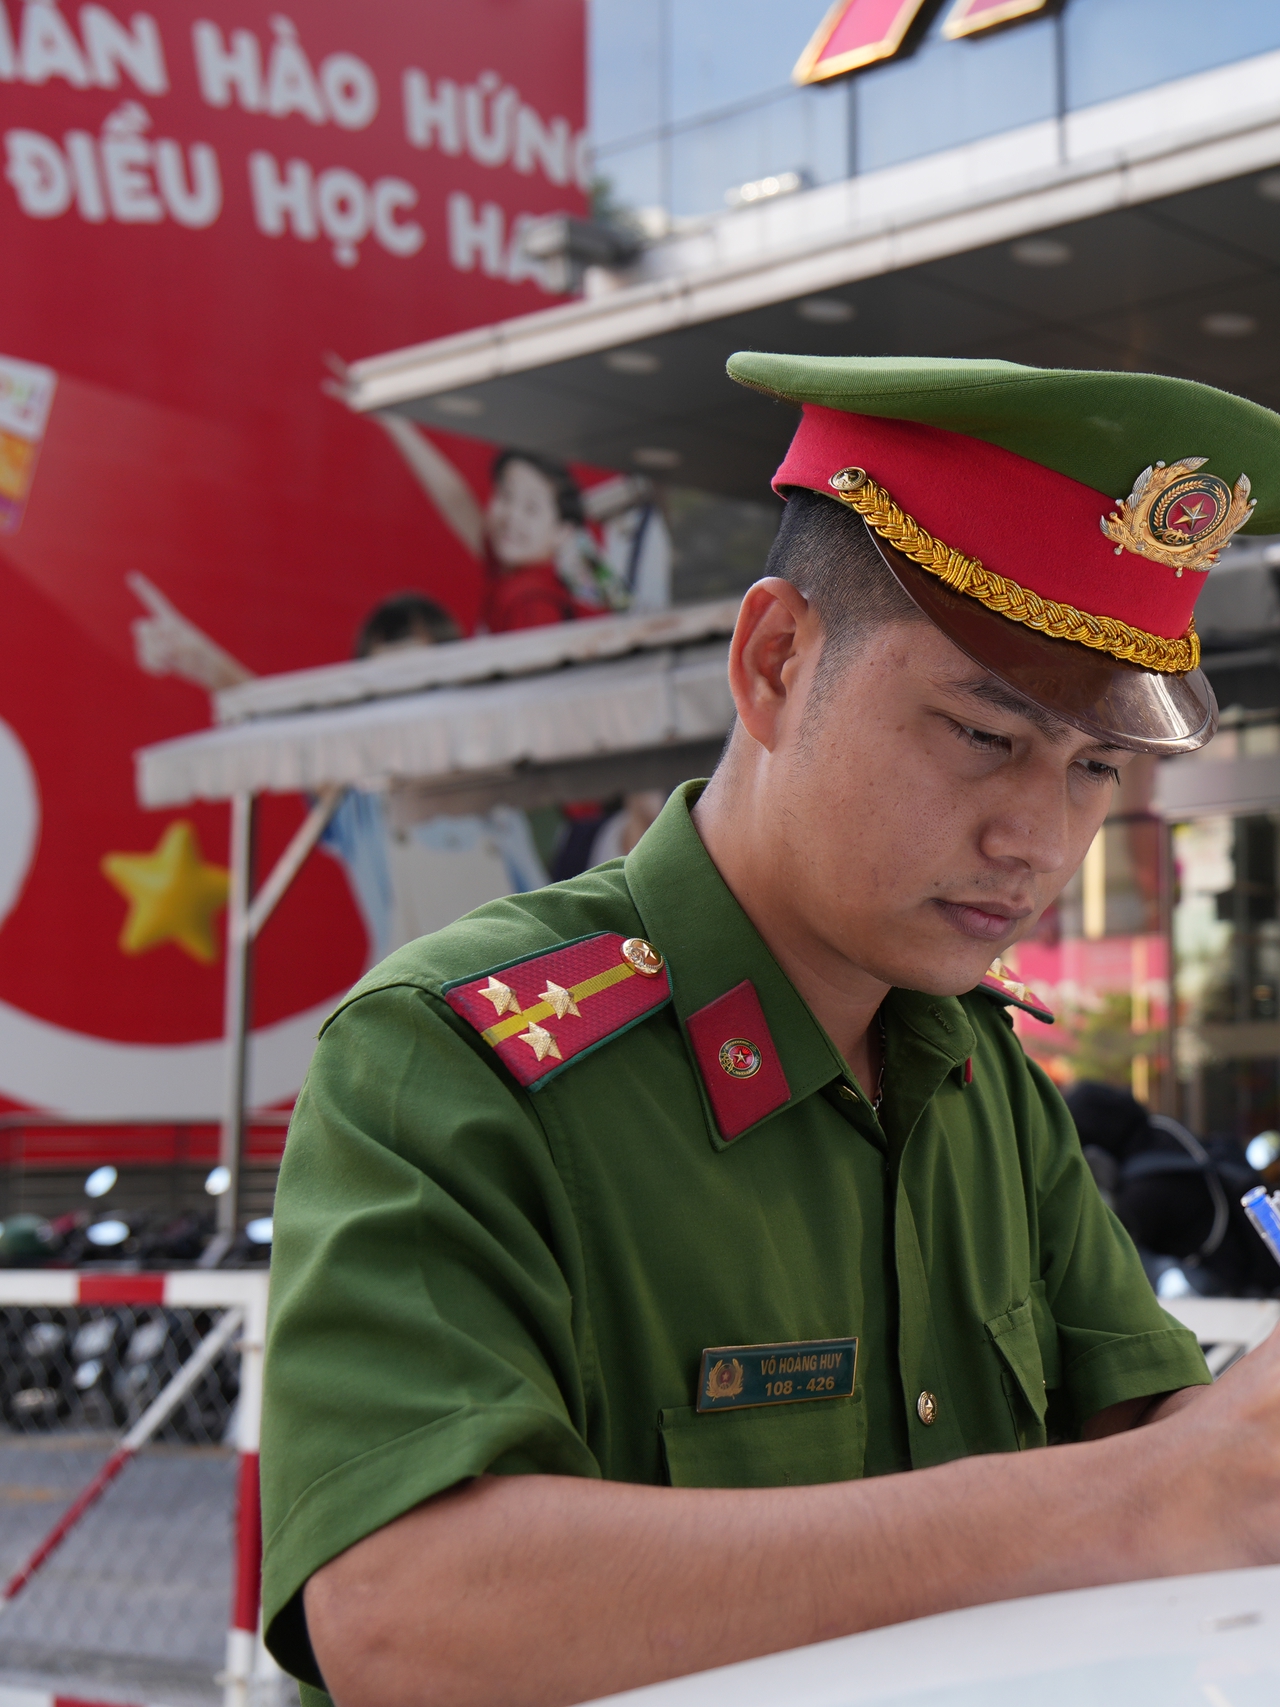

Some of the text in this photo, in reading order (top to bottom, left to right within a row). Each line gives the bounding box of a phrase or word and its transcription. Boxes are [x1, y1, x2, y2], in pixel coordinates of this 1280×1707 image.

[194, 14, 378, 130] HÀO
[3, 100, 222, 230] ĐIỀU
[249, 150, 425, 267] HỌC
[765, 1380, 793, 1397] 108
[806, 1376, 836, 1392] 426
[779, 1352, 817, 1374] HOÀNG
[820, 1352, 843, 1370] HUY
